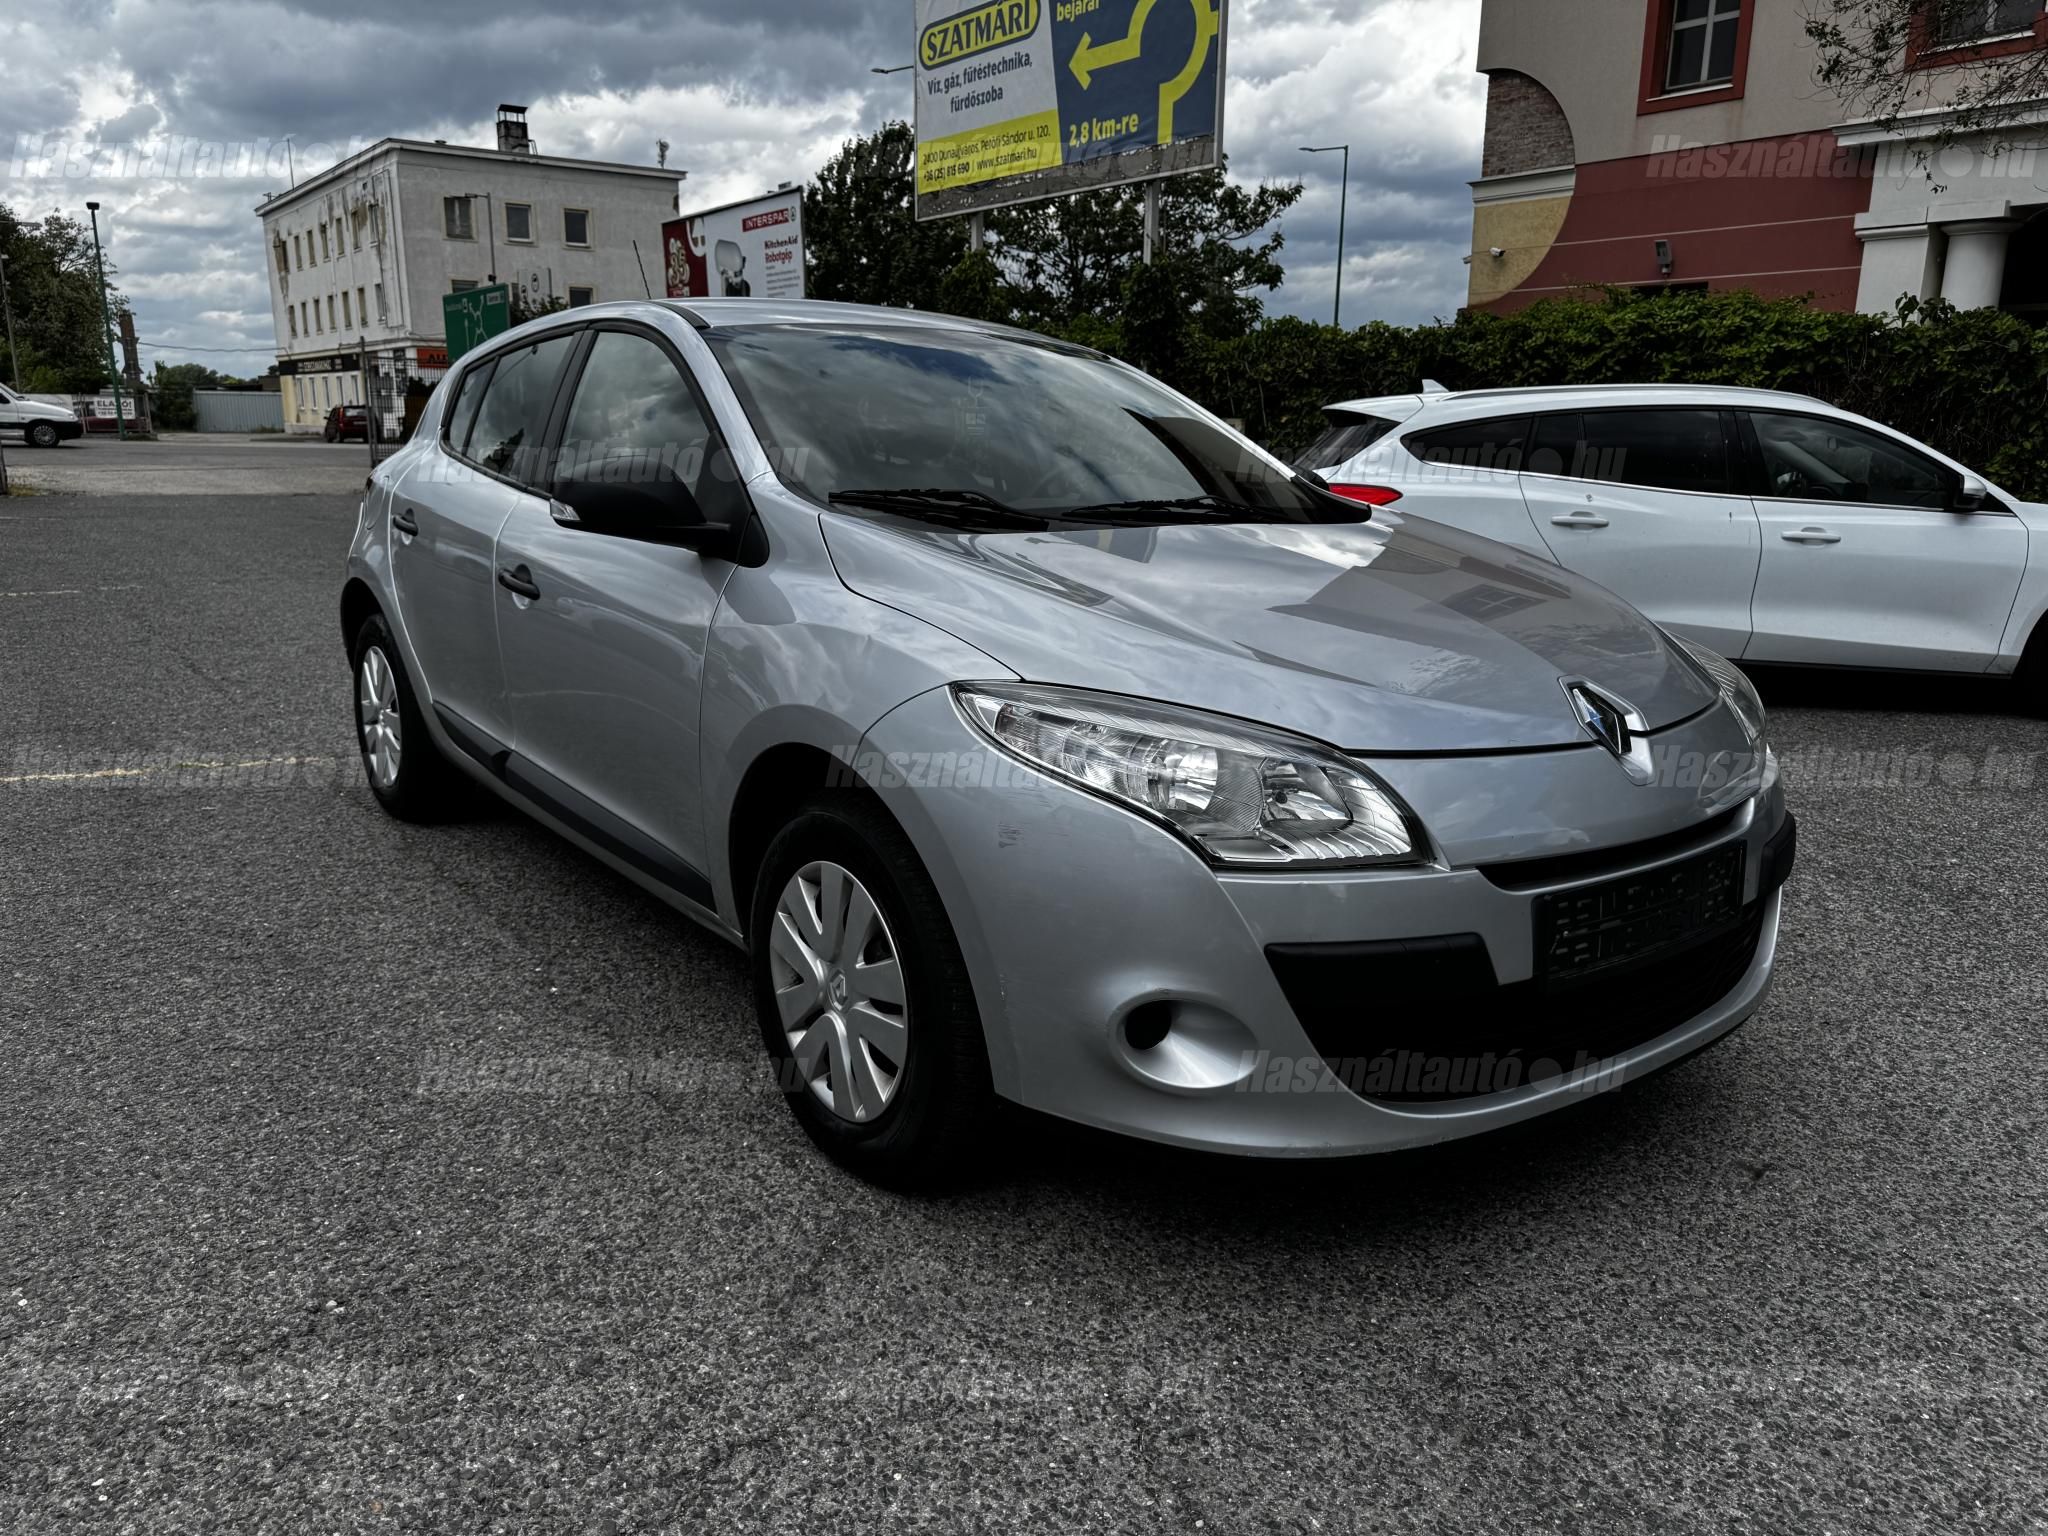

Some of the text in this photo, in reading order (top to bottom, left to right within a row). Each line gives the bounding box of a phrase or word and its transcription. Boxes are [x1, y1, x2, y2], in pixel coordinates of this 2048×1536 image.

[927, 0, 1030, 61] SZATMÁRI
[944, 71, 962, 94] gáz,
[1069, 113, 1139, 148] 2,8 km-re
[745, 210, 788, 229] INTERSPAR
